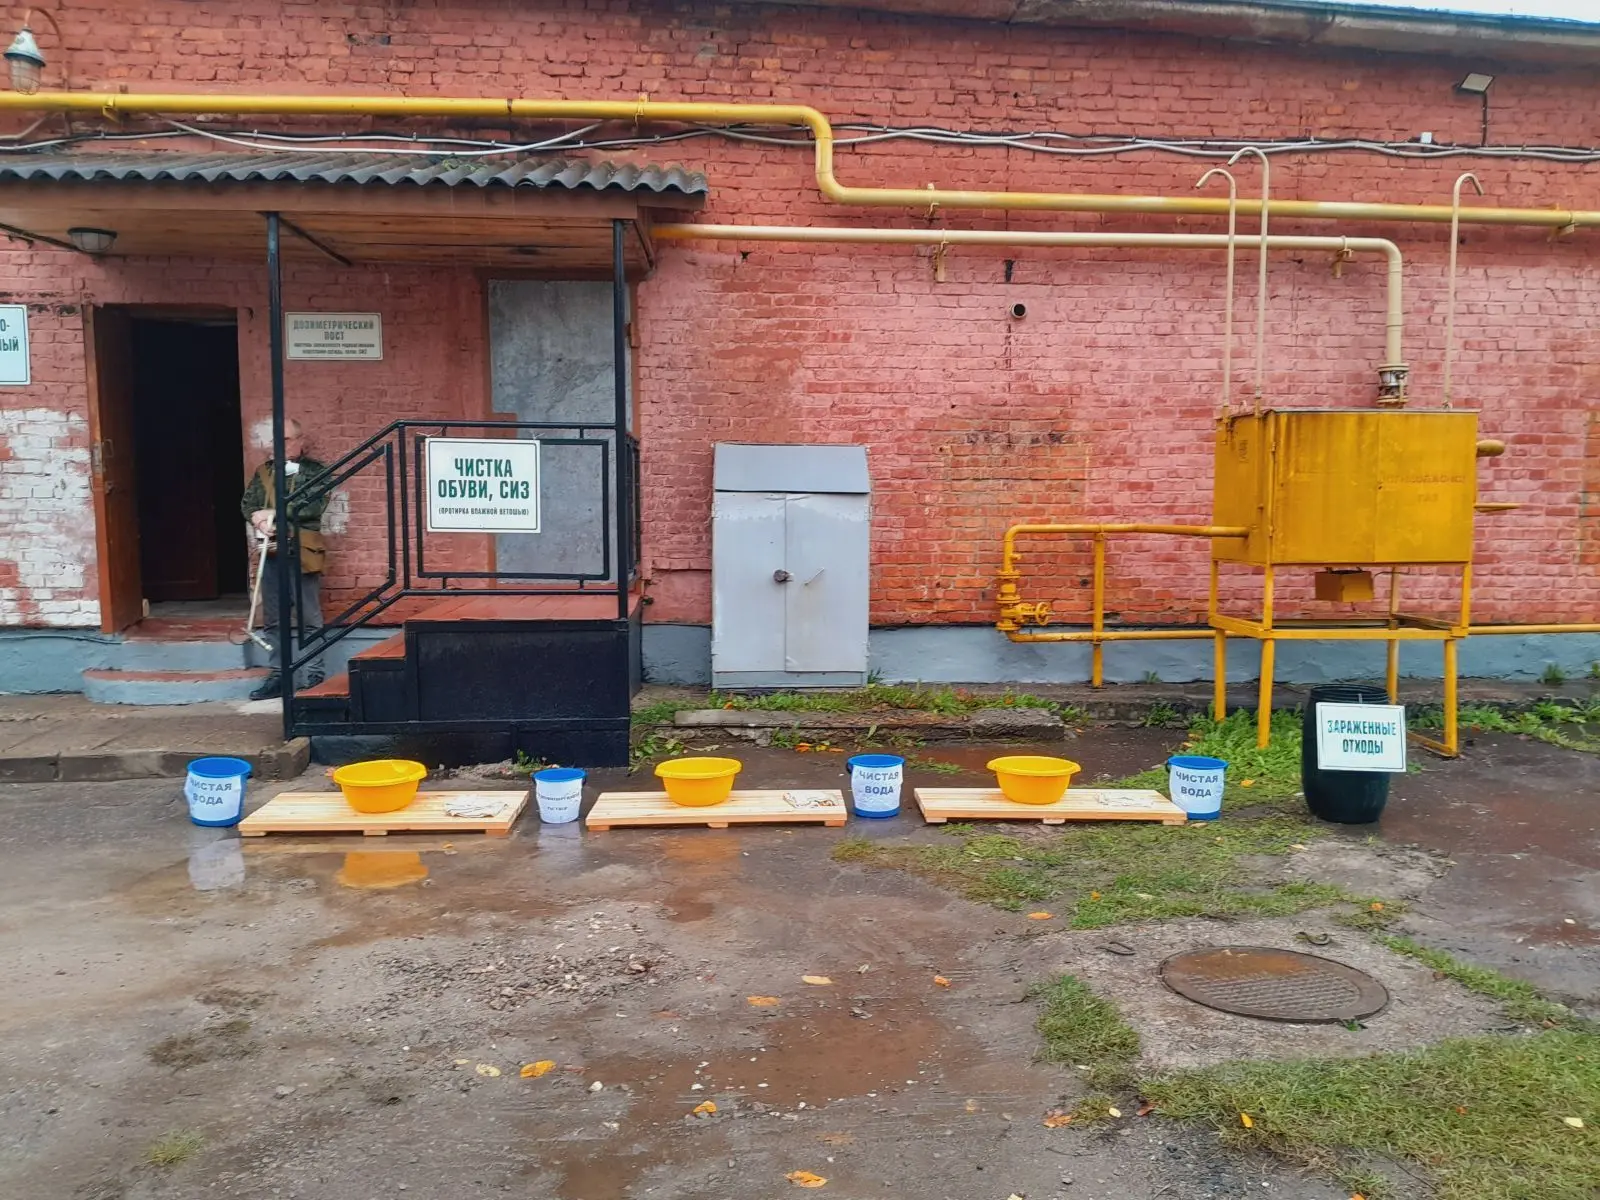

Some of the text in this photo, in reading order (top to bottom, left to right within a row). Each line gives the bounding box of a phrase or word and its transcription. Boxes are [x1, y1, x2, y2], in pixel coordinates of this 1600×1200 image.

[293, 319, 374, 330] ДОЗИМЕТРИЧЕСКИЙ
[324, 331, 344, 341] ПОСТ
[0, 336, 20, 352] ЫЙ
[454, 458, 513, 477] ЧИСТКА
[438, 479, 530, 501] ОБУВИ, СИЗ
[439, 507, 529, 516] (ПРОТИРКА ВЛАЖНОЙ ВЕТОШЬЮ)
[1327, 719, 1397, 736] ЗАРАЖЕННЫЕ
[1342, 738, 1384, 755] ОТХОДЫ
[859, 770, 899, 781] ЧИСТАЯ
[1175, 770, 1218, 783] ЧИСТАЯ
[864, 785, 895, 795] ВОДА
[1180, 786, 1211, 798] ВОДА
[192, 792, 223, 805] ВОДА
